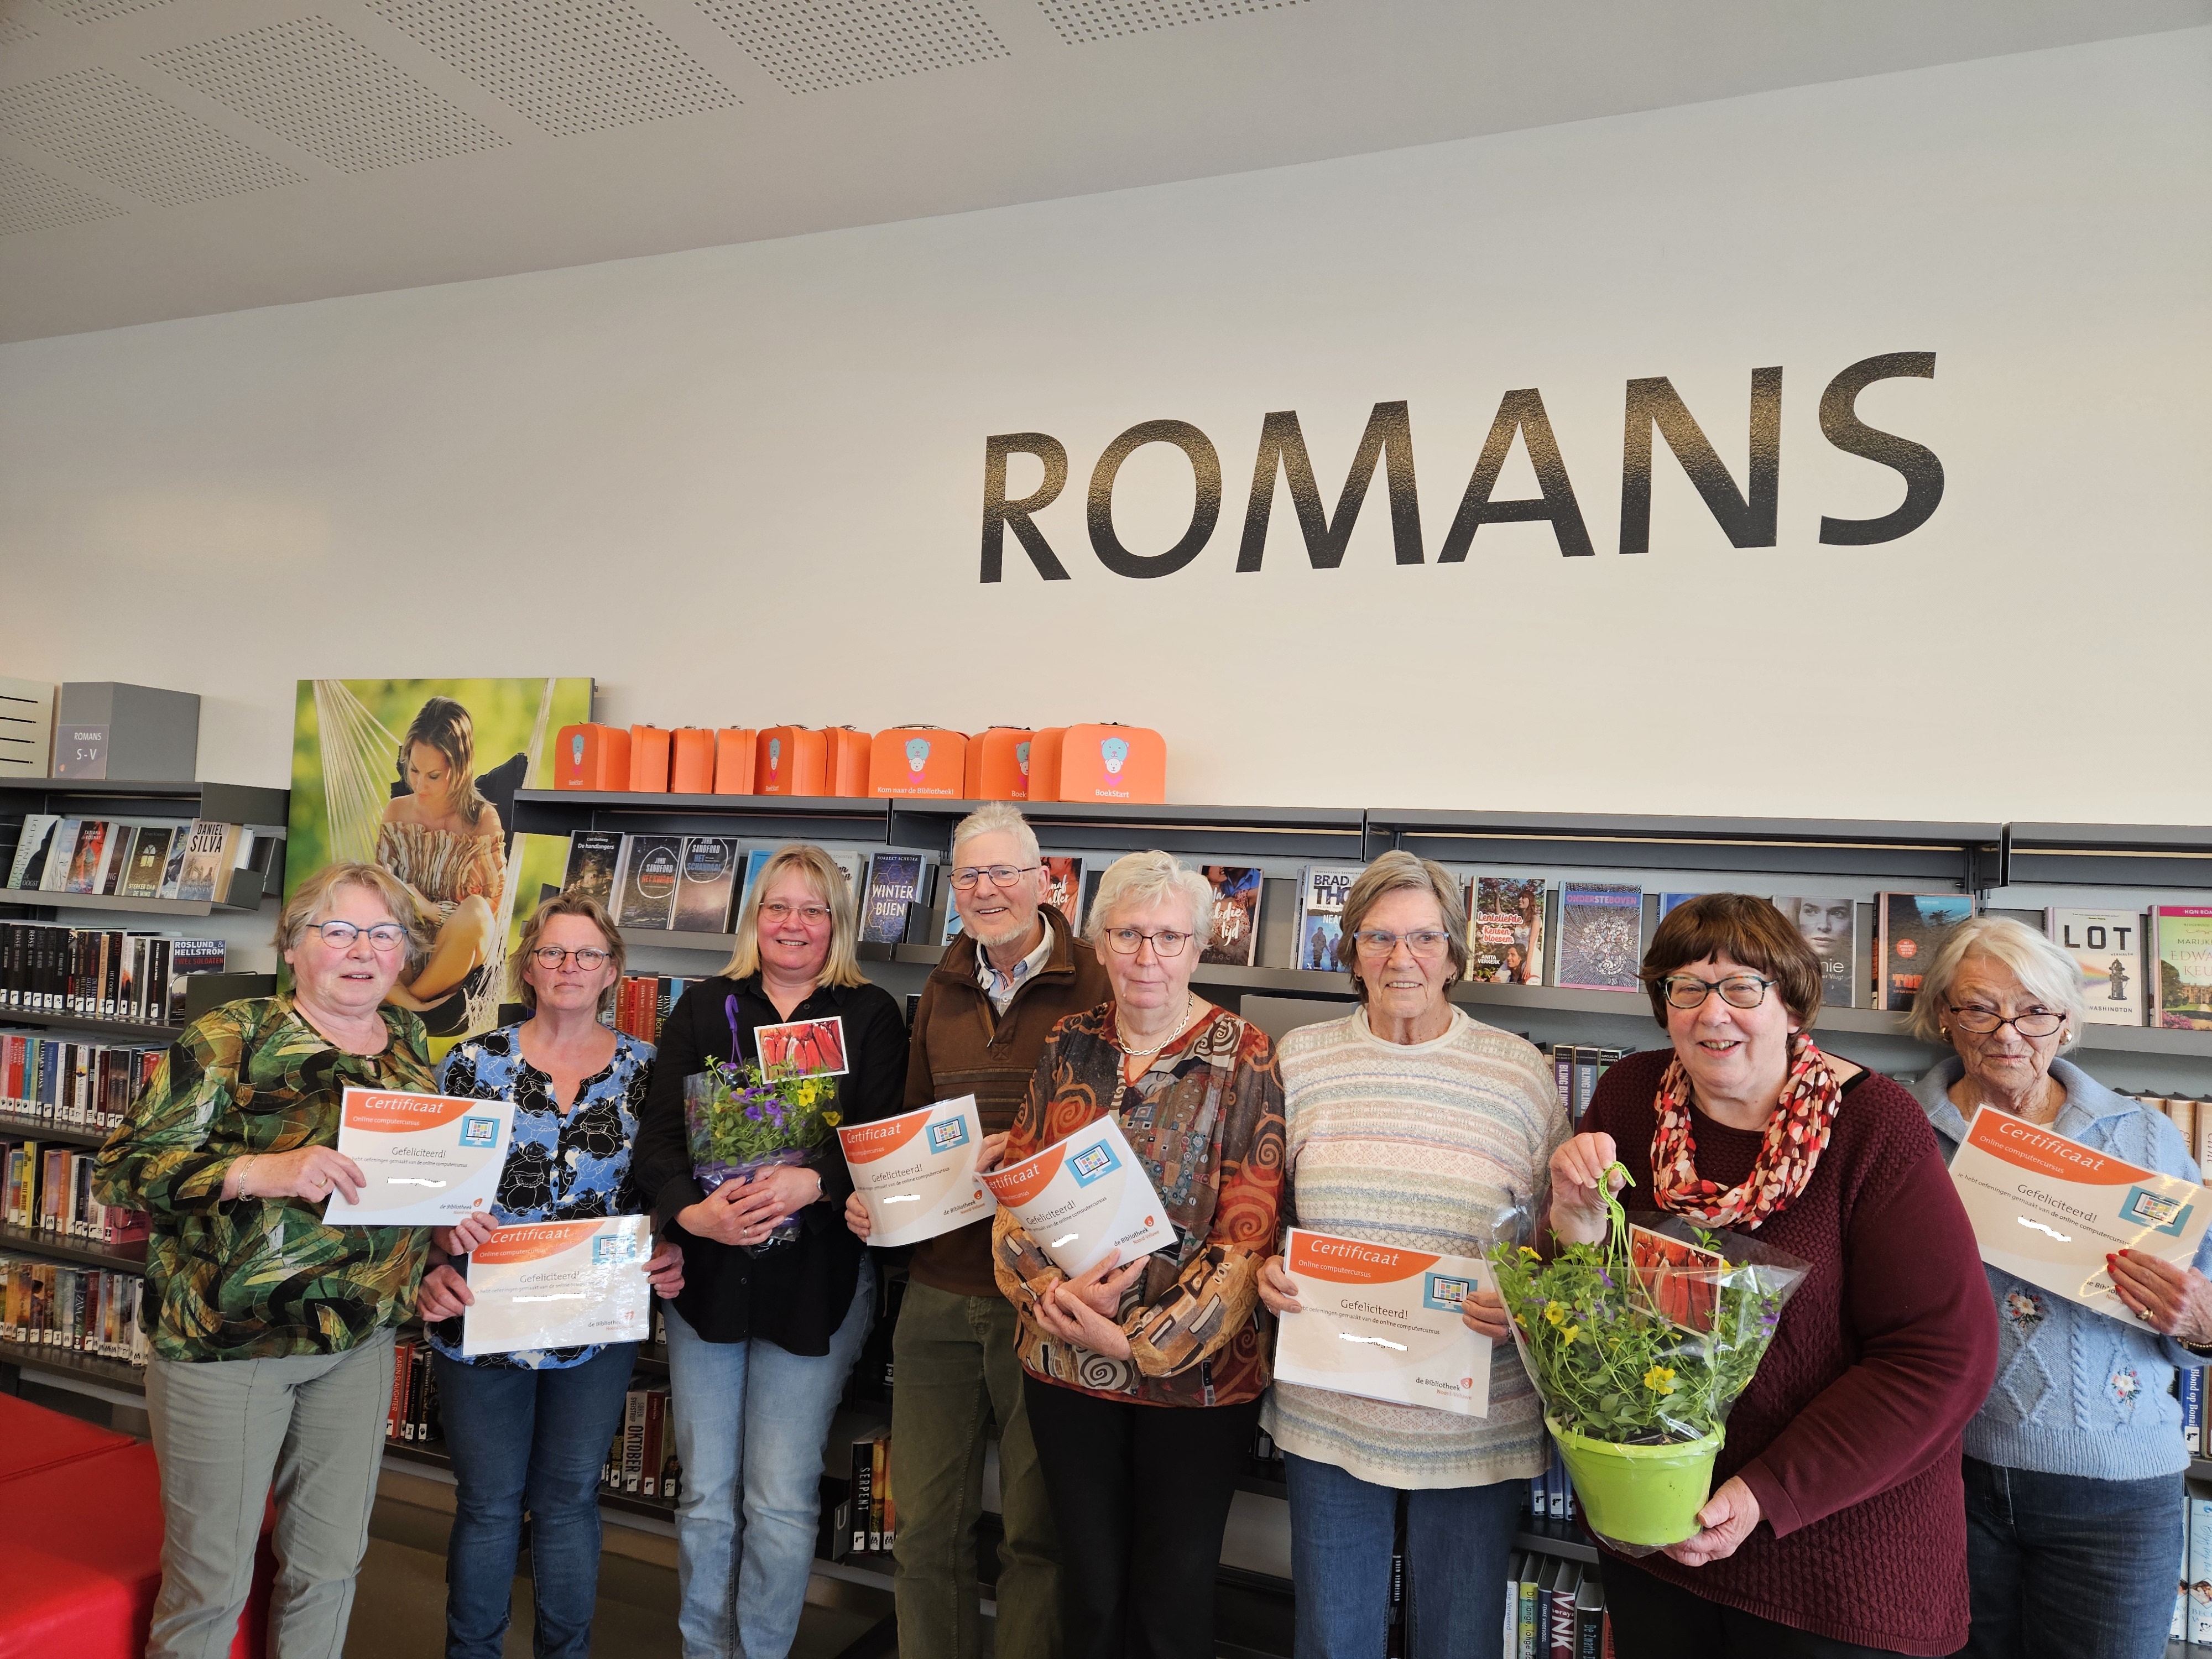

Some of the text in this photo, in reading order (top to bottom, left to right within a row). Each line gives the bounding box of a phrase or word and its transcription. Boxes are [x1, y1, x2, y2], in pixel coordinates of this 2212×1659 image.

[979, 351, 1945, 583] ROMANS
[1095, 789, 1129, 799] BoekStart
[197, 824, 223, 836] DANIEL
[190, 836, 222, 853] SILVA
[692, 844, 720, 853] SANDFORD
[646, 864, 674, 873] SANDFORD
[1314, 875, 1349, 885] BRAD
[873, 884, 913, 899] WINTER
[1567, 894, 1636, 905] ONDERSTEBOVEN
[875, 902, 905, 916] BIJEN
[1478, 912, 1522, 923] Lenteliefde
[1221, 920, 1240, 946] tijd
[1484, 935, 1514, 943] bloesem
[2064, 925, 2131, 950] LOT
[174, 947, 224, 956] HELLSTRÖM
[1559, 1065, 1568, 1085] BLING
[1582, 1068, 1591, 1087] BLING
[365, 1097, 444, 1114] Certificaat
[847, 1123, 901, 1144] Certificaat
[392, 1147, 446, 1158] Gefeliciteerd!
[1980, 1135, 2065, 1174] Online computercursus
[2000, 1123, 2105, 1171] Certificaat
[872, 1164, 922, 1182] Gefeliciteerd!
[916, 1167, 950, 1181] computercursus
[985, 1163, 1040, 1190] Certificaat
[950, 1200, 976, 1213] Bibliotheek
[1026, 1200, 1076, 1225] Gefeliciteerd!
[1059, 1214, 1072, 1224] online
[1072, 1197, 1107, 1219] computercursus
[1964, 1173, 1978, 1183] hebt
[1978, 1180, 2012, 1197] oefeningen
[2012, 1194, 2038, 1210] gemaakt
[2059, 1214, 2079, 1227] online
[2079, 1224, 2131, 1246] computercursus
[2017, 1184, 2098, 1223] Gefeliciteerd!
[491, 1227, 571, 1244] Certificaat
[1121, 1227, 1149, 1244] Bibliotheek
[499, 1248, 546, 1256] computercursus
[1311, 1239, 1400, 1266] Certificaat
[520, 1271, 580, 1283] Gefeliciteerd!
[1298, 1259, 1371, 1278] Online computercursus
[1341, 1299, 1408, 1319] Gefeliciteerd!
[1309, 1307, 1338, 1317] oefeningen
[1339, 1312, 1361, 1321] gemaakt
[1380, 1319, 1396, 1327] online
[1397, 1323, 1440, 1335] computercursus
[392, 1376, 401, 1411] SLAUGHTER
[1425, 1378, 1460, 1391] Bibliotheek
[2187, 1369, 2199, 1402] Blond op
[1437, 1389, 1472, 1401] Noord-Veluwe
[625, 1426, 644, 1472] OKTOBER
[858, 1468, 870, 1510] SERPENT
[1525, 1605, 1533, 1627] lange,
[1524, 1630, 1533, 1649] lange
[1583, 1634, 1597, 1654] Zwarte
